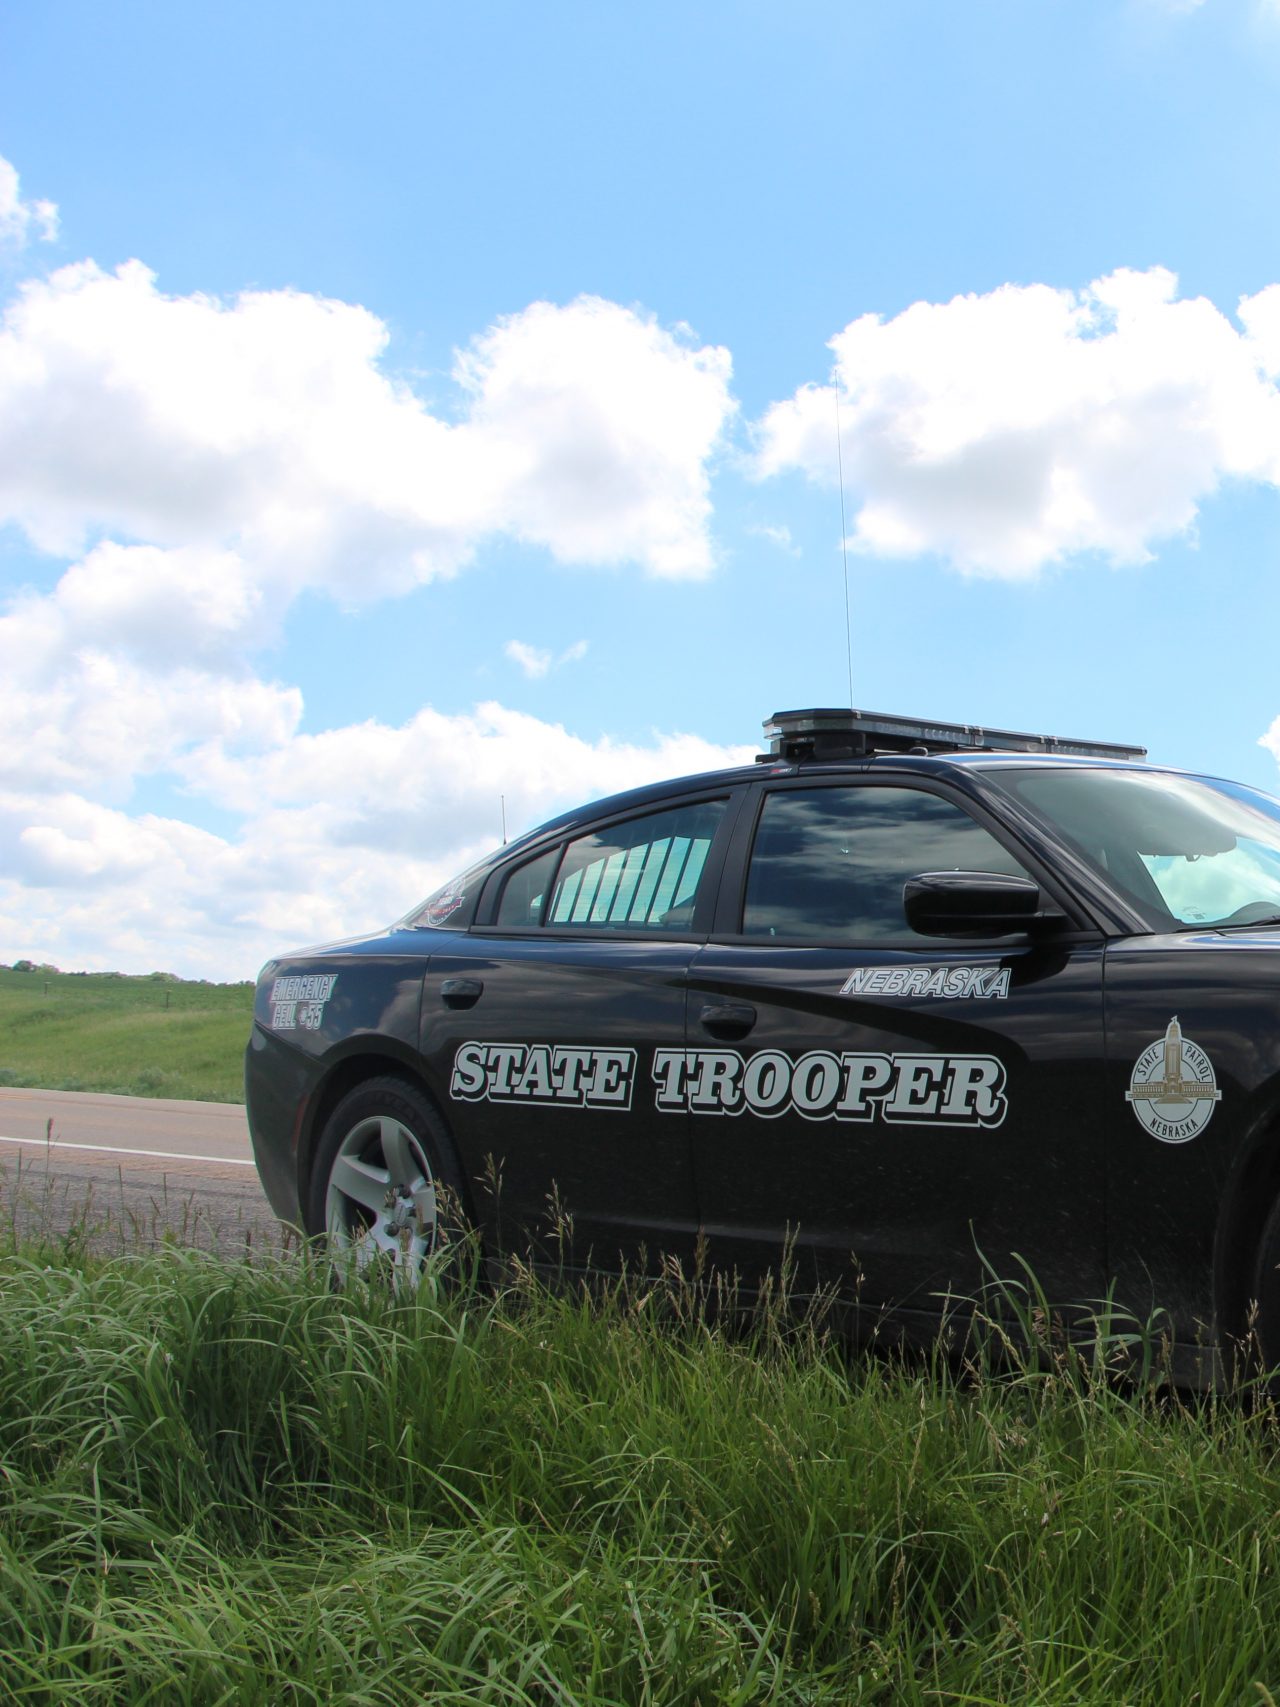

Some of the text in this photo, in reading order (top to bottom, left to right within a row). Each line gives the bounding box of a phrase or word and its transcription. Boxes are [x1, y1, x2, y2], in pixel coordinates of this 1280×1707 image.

[269, 974, 338, 1003] EMERGENCY
[840, 968, 1011, 999] NEBRASKA
[272, 1004, 297, 1029] CELL
[1138, 1047, 1211, 1081] STATE PATROL
[449, 1041, 634, 1111] STATE
[652, 1048, 1008, 1129] TROOPER
[1150, 1118, 1198, 1138] NEBRASKA
